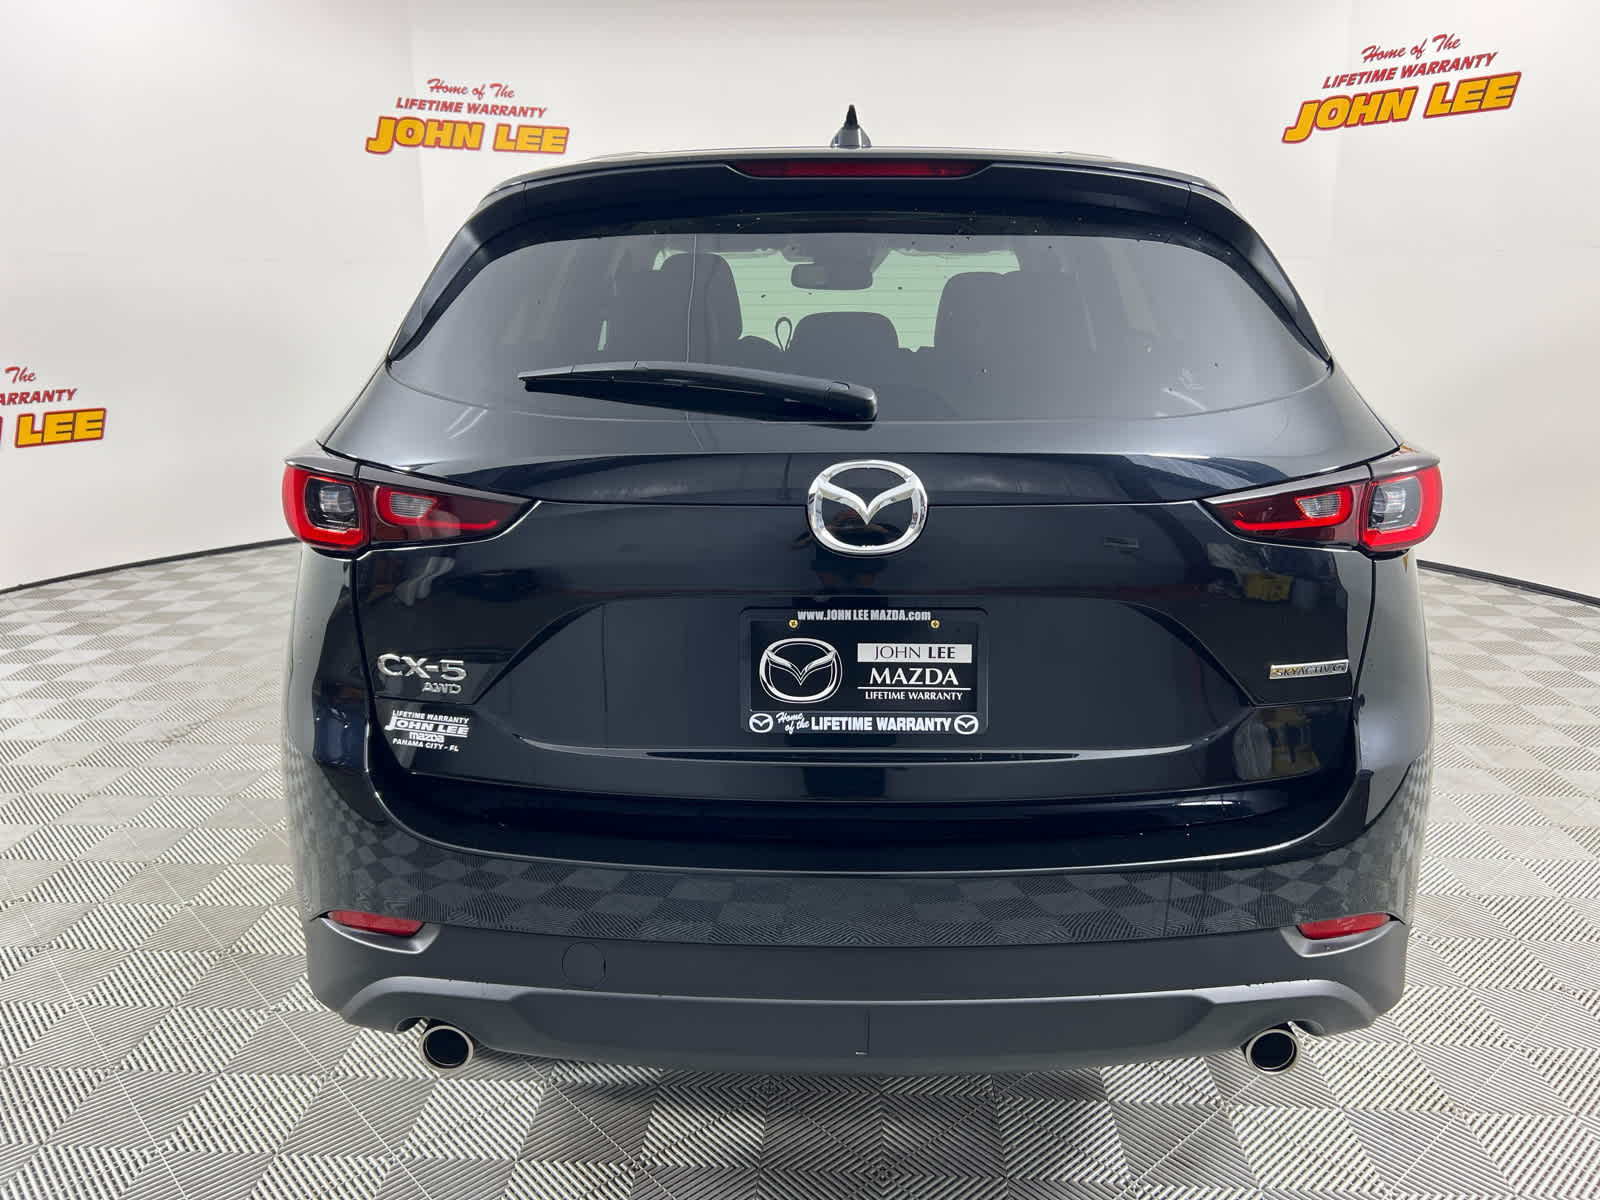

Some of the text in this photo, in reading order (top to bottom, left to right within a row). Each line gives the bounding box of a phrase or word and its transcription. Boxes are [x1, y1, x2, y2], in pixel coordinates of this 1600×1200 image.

[1361, 33, 1462, 63] Home of The
[1322, 52, 1498, 89] LIFETIME WARRANTY
[427, 78, 515, 100] Home of The
[396, 97, 547, 118] LIFETIME WARRANTY
[1282, 71, 1522, 143] JOHN LEE
[365, 116, 570, 155] JOHN LEE
[5, 366, 36, 384] The
[0, 388, 77, 406] ARRANTY
[15, 408, 106, 448] LEE
[853, 610, 870, 620] LEE
[874, 646, 956, 660] JOHN LEE
[377, 653, 467, 681] CX-5
[869, 668, 959, 686] MAZDA
[422, 682, 461, 694] AWD
[865, 691, 963, 701] LIFETIME WARRANTY
[392, 710, 470, 724] LIFETIME WARRANTY
[775, 712, 804, 724] Home
[811, 716, 950, 731] LIFETIME WARRANTY
[384, 717, 469, 736] JOHN LEE
[785, 719, 810, 735] of the
[392, 738, 424, 748] PANAMA
